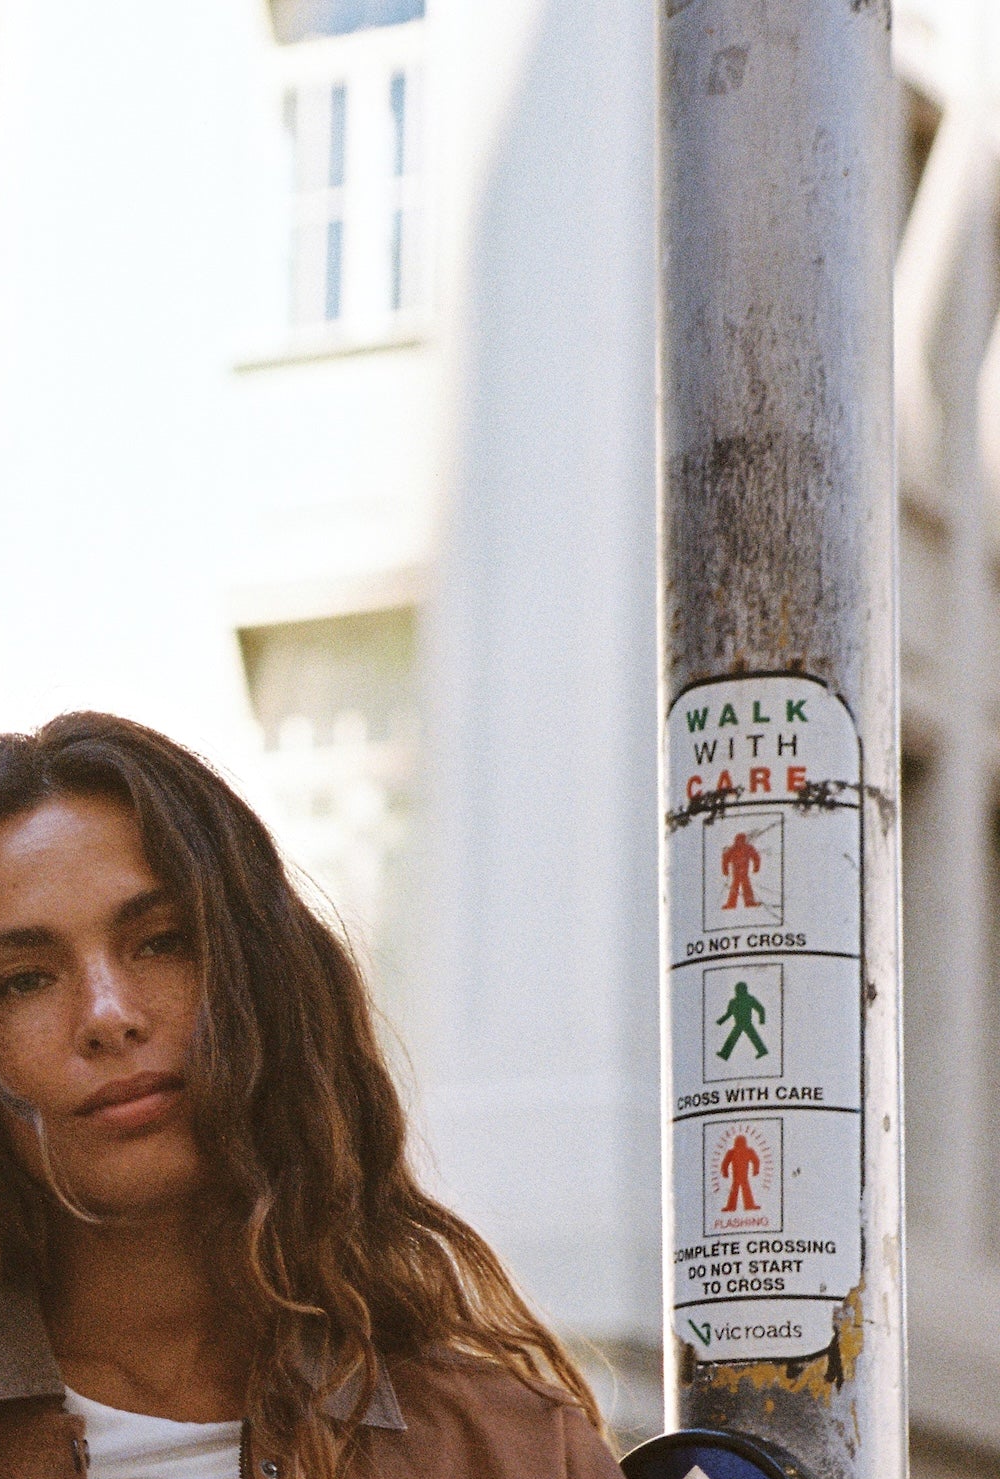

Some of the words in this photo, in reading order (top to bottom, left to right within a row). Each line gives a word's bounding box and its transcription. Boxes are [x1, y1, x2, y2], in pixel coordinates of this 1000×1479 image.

[686, 700, 808, 732] WALK
[694, 734, 797, 765] WITH
[686, 766, 807, 800] CARE
[687, 941, 704, 955] DO
[709, 936, 741, 949] NOT
[747, 933, 807, 947] CROSS
[677, 1091, 720, 1110] CROSS
[725, 1086, 769, 1102] WITH
[775, 1086, 824, 1100] CARE
[714, 1216, 769, 1229] FLASHING
[746, 1240, 836, 1254] CROSSING
[688, 1265, 706, 1280] DO
[711, 1261, 742, 1276] NOT
[748, 1260, 803, 1274] START
[702, 1281, 721, 1295] TO
[727, 1278, 785, 1293] CROSS
